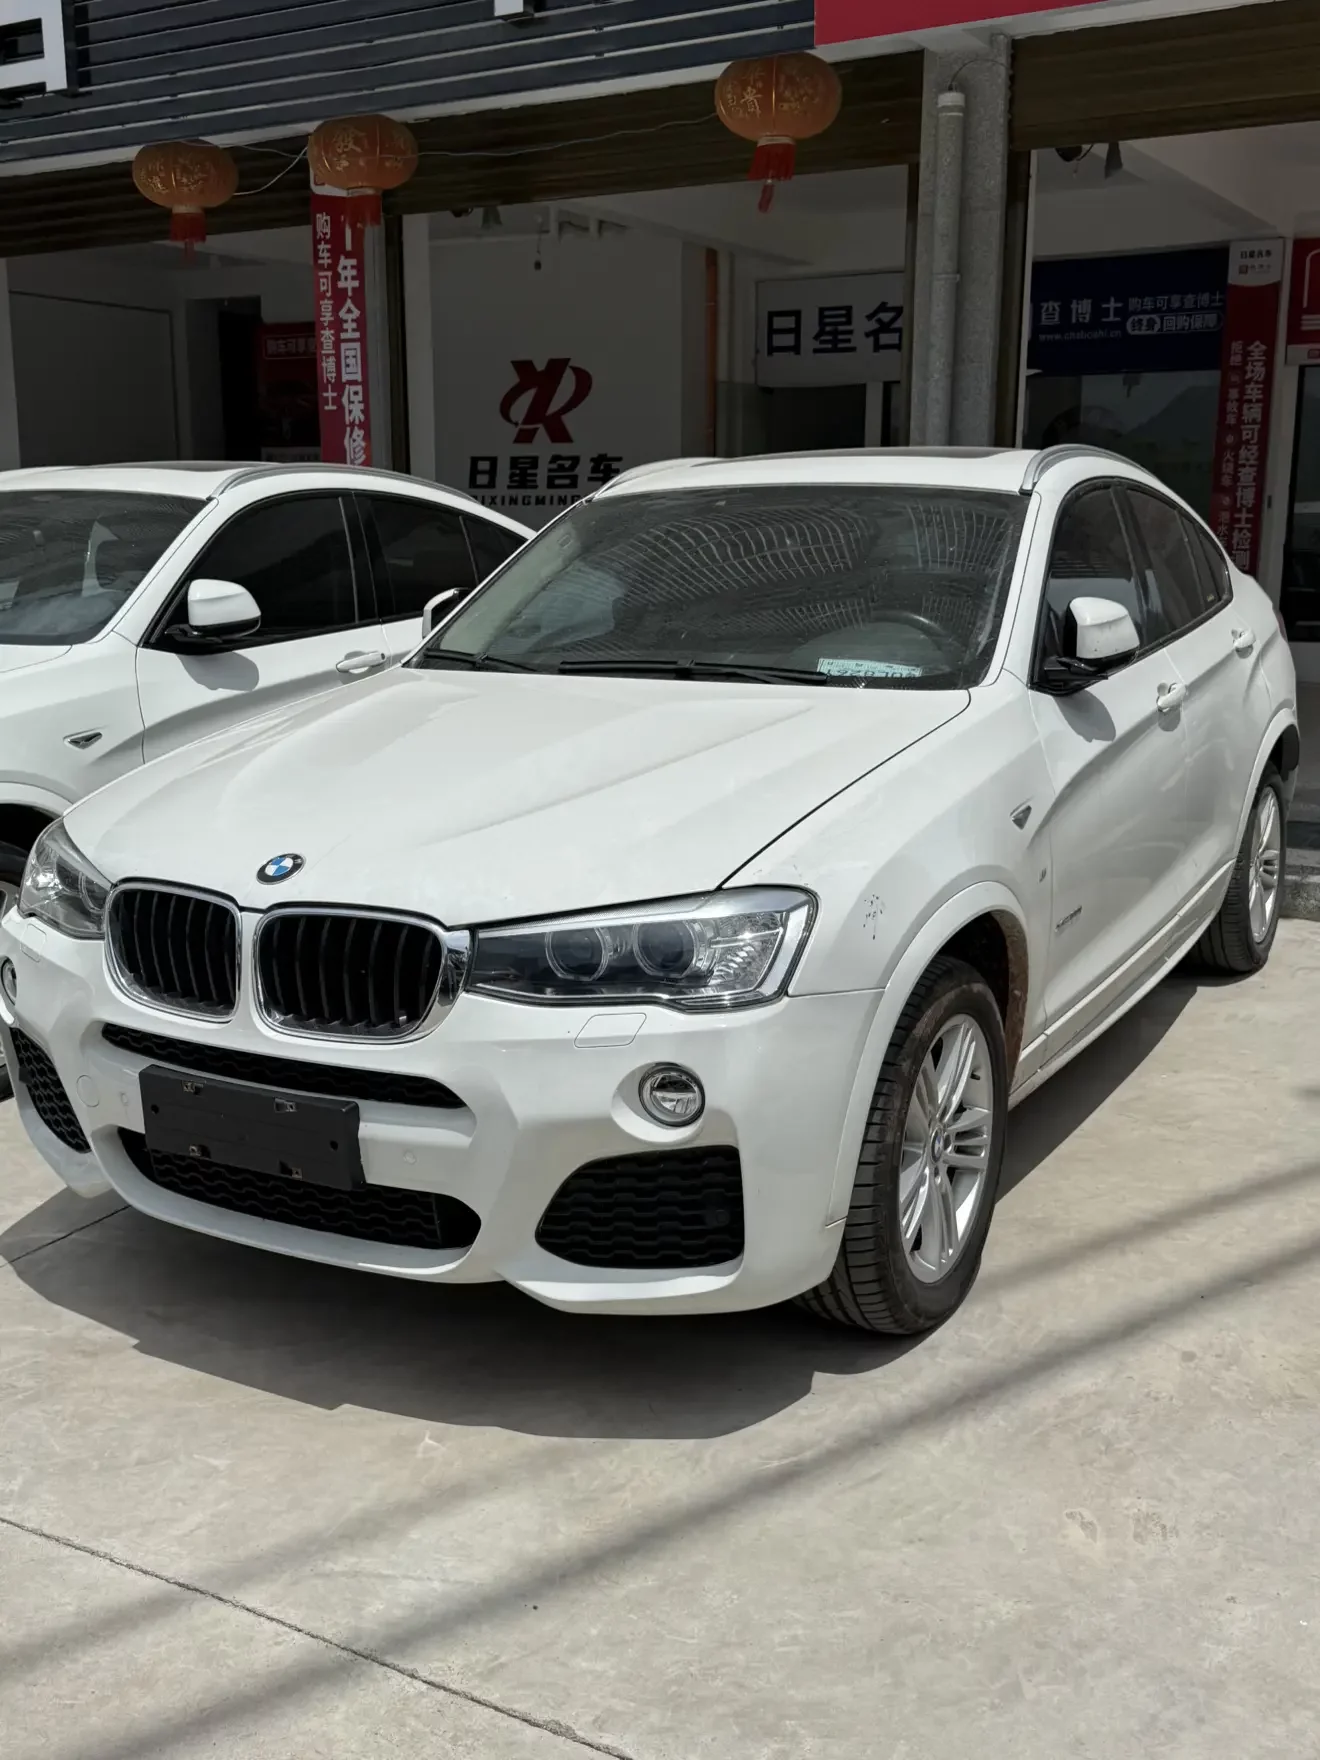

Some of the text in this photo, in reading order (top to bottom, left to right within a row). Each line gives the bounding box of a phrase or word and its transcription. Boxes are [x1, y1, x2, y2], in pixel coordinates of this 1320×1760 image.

[315, 212, 337, 411] 购车可享查博士
[1038, 296, 1124, 326] 查博士
[1128, 290, 1225, 312] 购车可享查博士
[767, 301, 904, 356] 日星名
[468, 453, 623, 489] 日星名车
[1231, 341, 1268, 570] 全场车辆可经查博士检测
